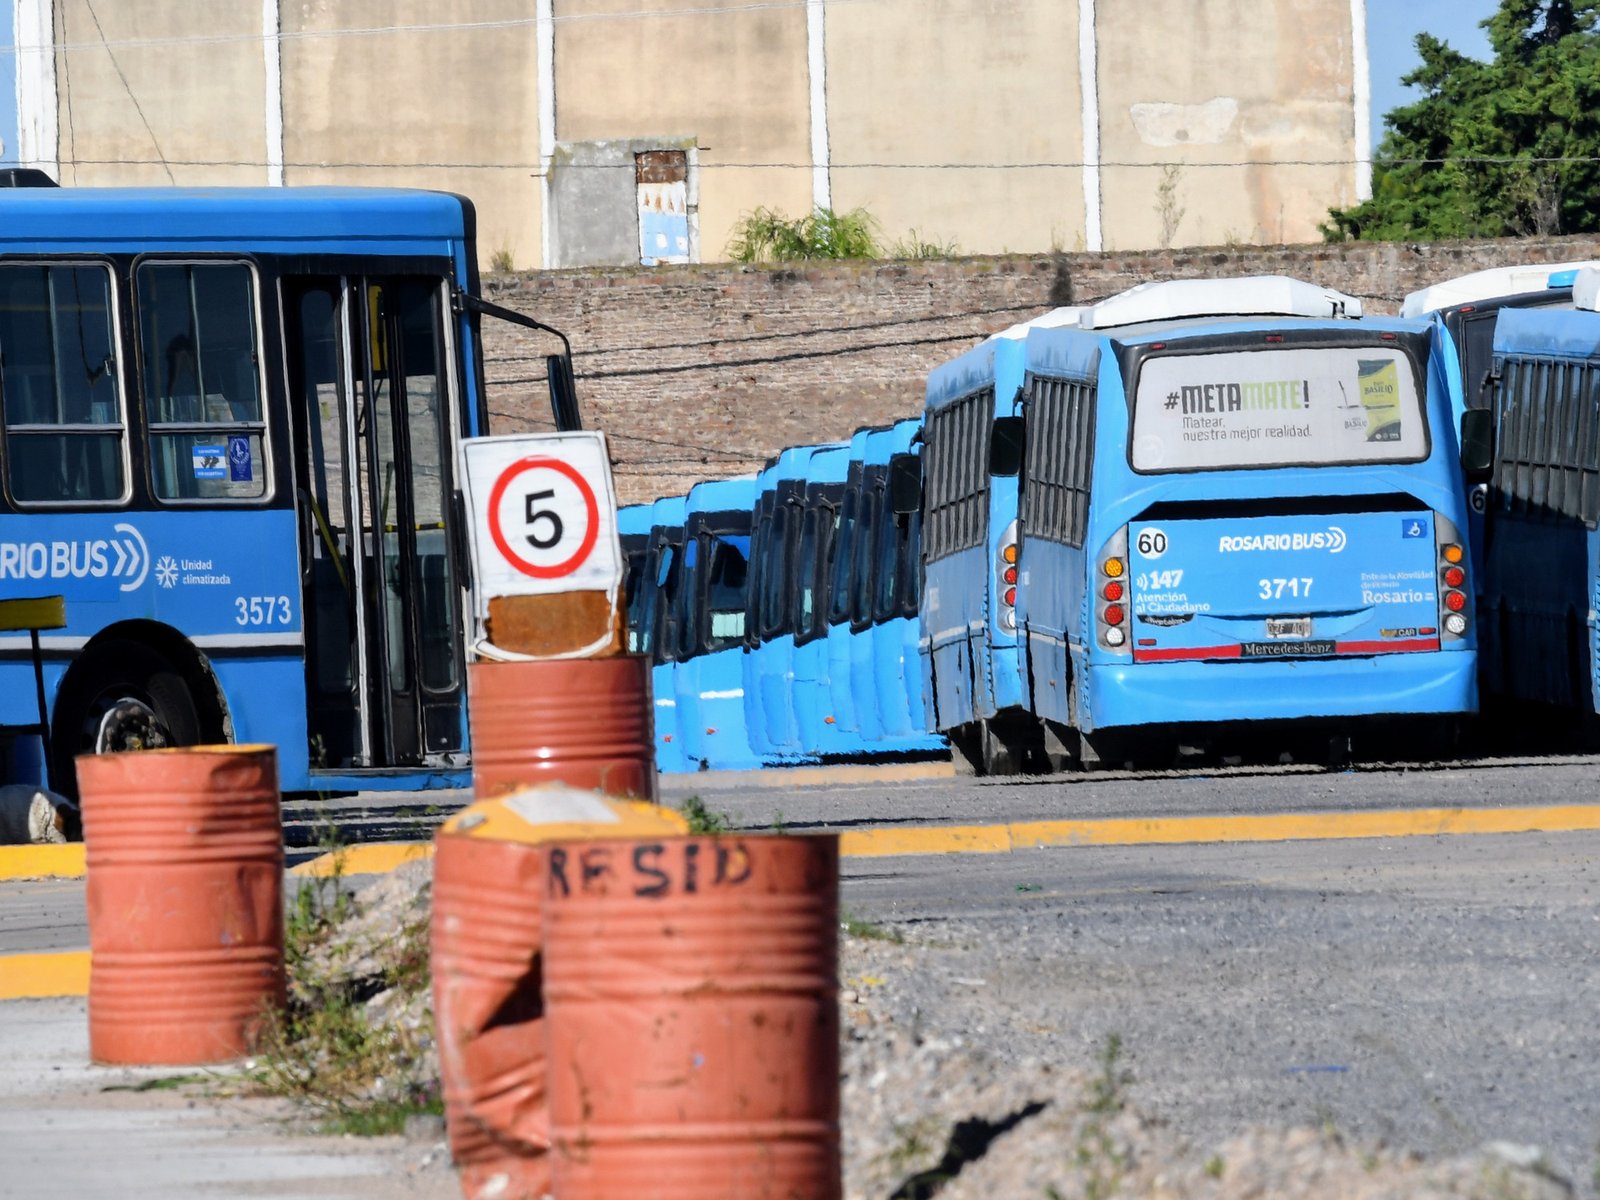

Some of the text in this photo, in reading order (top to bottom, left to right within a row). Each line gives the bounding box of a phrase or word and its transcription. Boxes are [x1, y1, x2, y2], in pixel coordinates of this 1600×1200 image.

[1164, 380, 1310, 414] #METAMATE!
[1183, 429, 1227, 442] nuestra
[1230, 426, 1262, 442] mejor
[525, 488, 563, 549] 5
[1138, 533, 1167, 554] 60
[181, 560, 212, 571] Unidad
[182, 574, 231, 585] climatizada
[1149, 569, 1184, 590] 147
[1259, 577, 1314, 600] 3717
[1135, 591, 1187, 603] Atención
[1362, 589, 1423, 605] Rosario
[235, 596, 292, 625] 3573
[1147, 602, 1211, 613] Ciudadano
[1245, 642, 1332, 655] Mercedes-Benz
